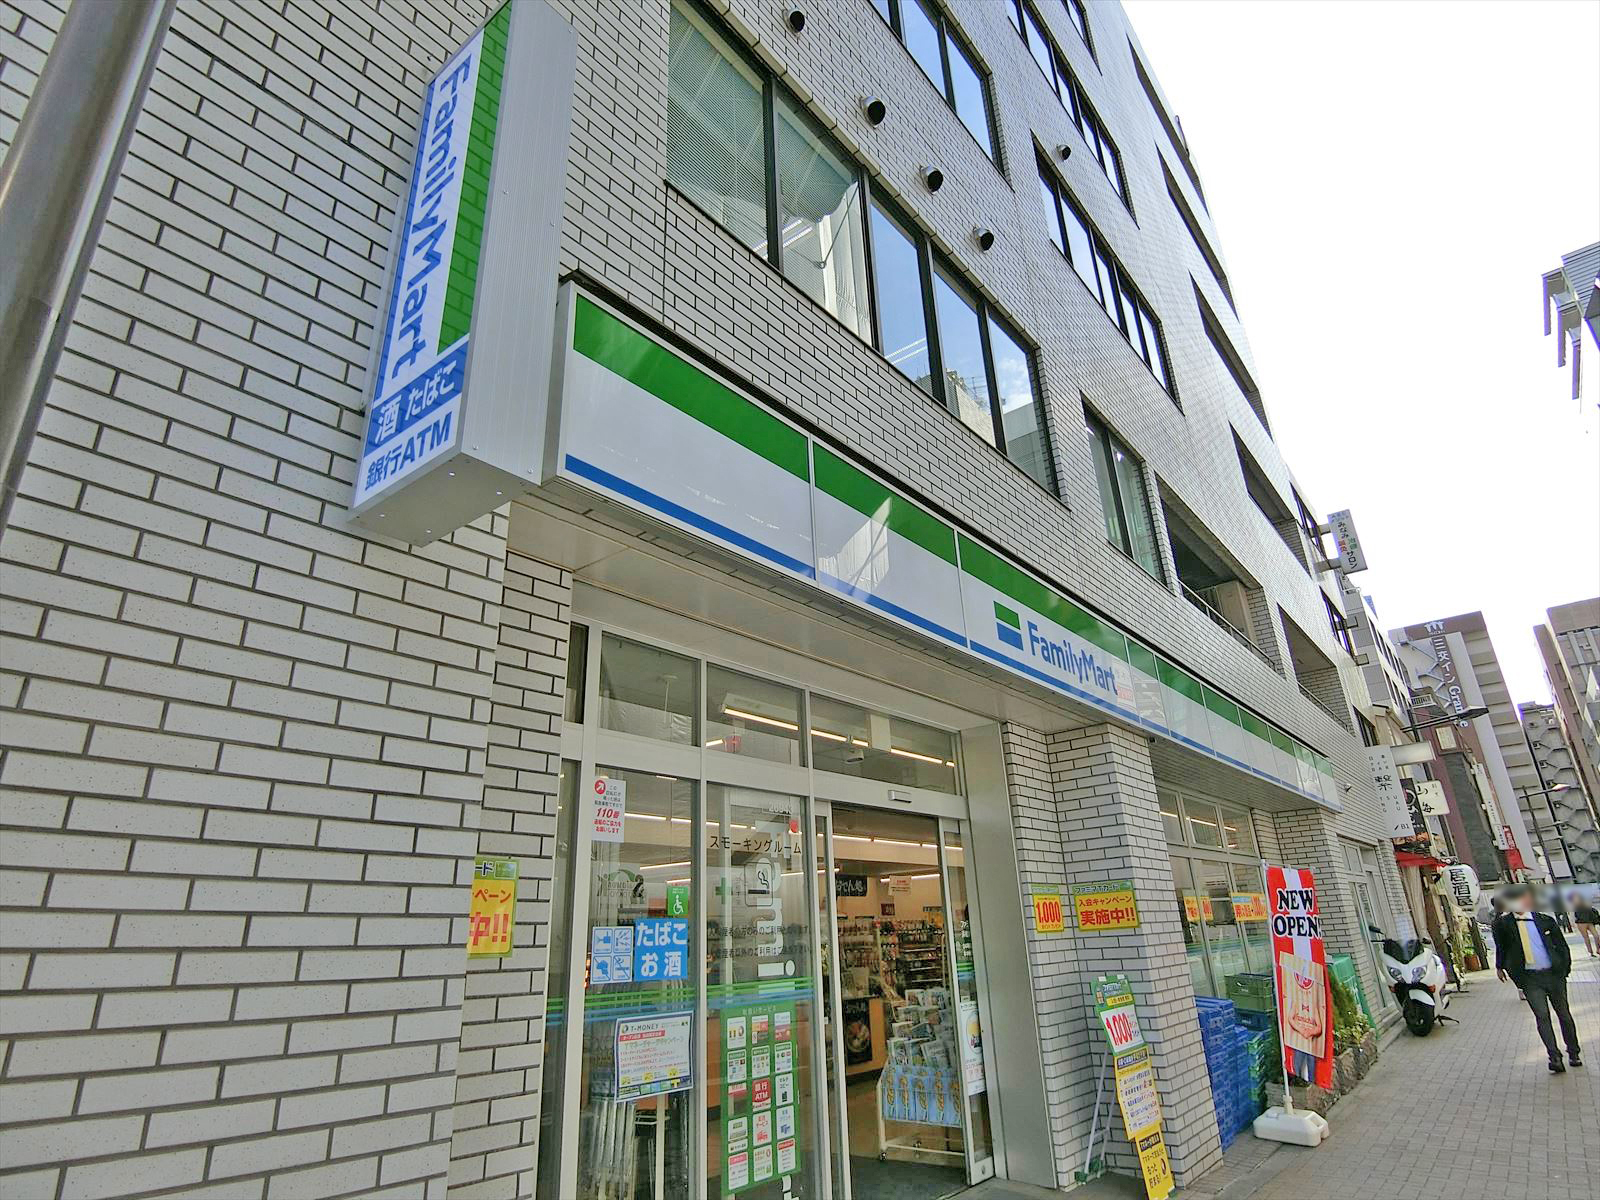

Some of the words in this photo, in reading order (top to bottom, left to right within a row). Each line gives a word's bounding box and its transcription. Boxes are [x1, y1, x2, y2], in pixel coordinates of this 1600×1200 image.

[392, 53, 472, 380] FamilyMart
[374, 394, 402, 444] 酒
[405, 360, 457, 421] たばこ
[365, 411, 453, 491] 銀行ATM
[1026, 620, 1119, 696] FamilyMart
[1448, 685, 1469, 729] Grane
[709, 835, 802, 855] スモーキングルーム
[1080, 907, 1136, 926] 実施中!!
[1277, 889, 1314, 911] NEW
[636, 921, 688, 947] たばこ
[640, 951, 683, 978] お酒
